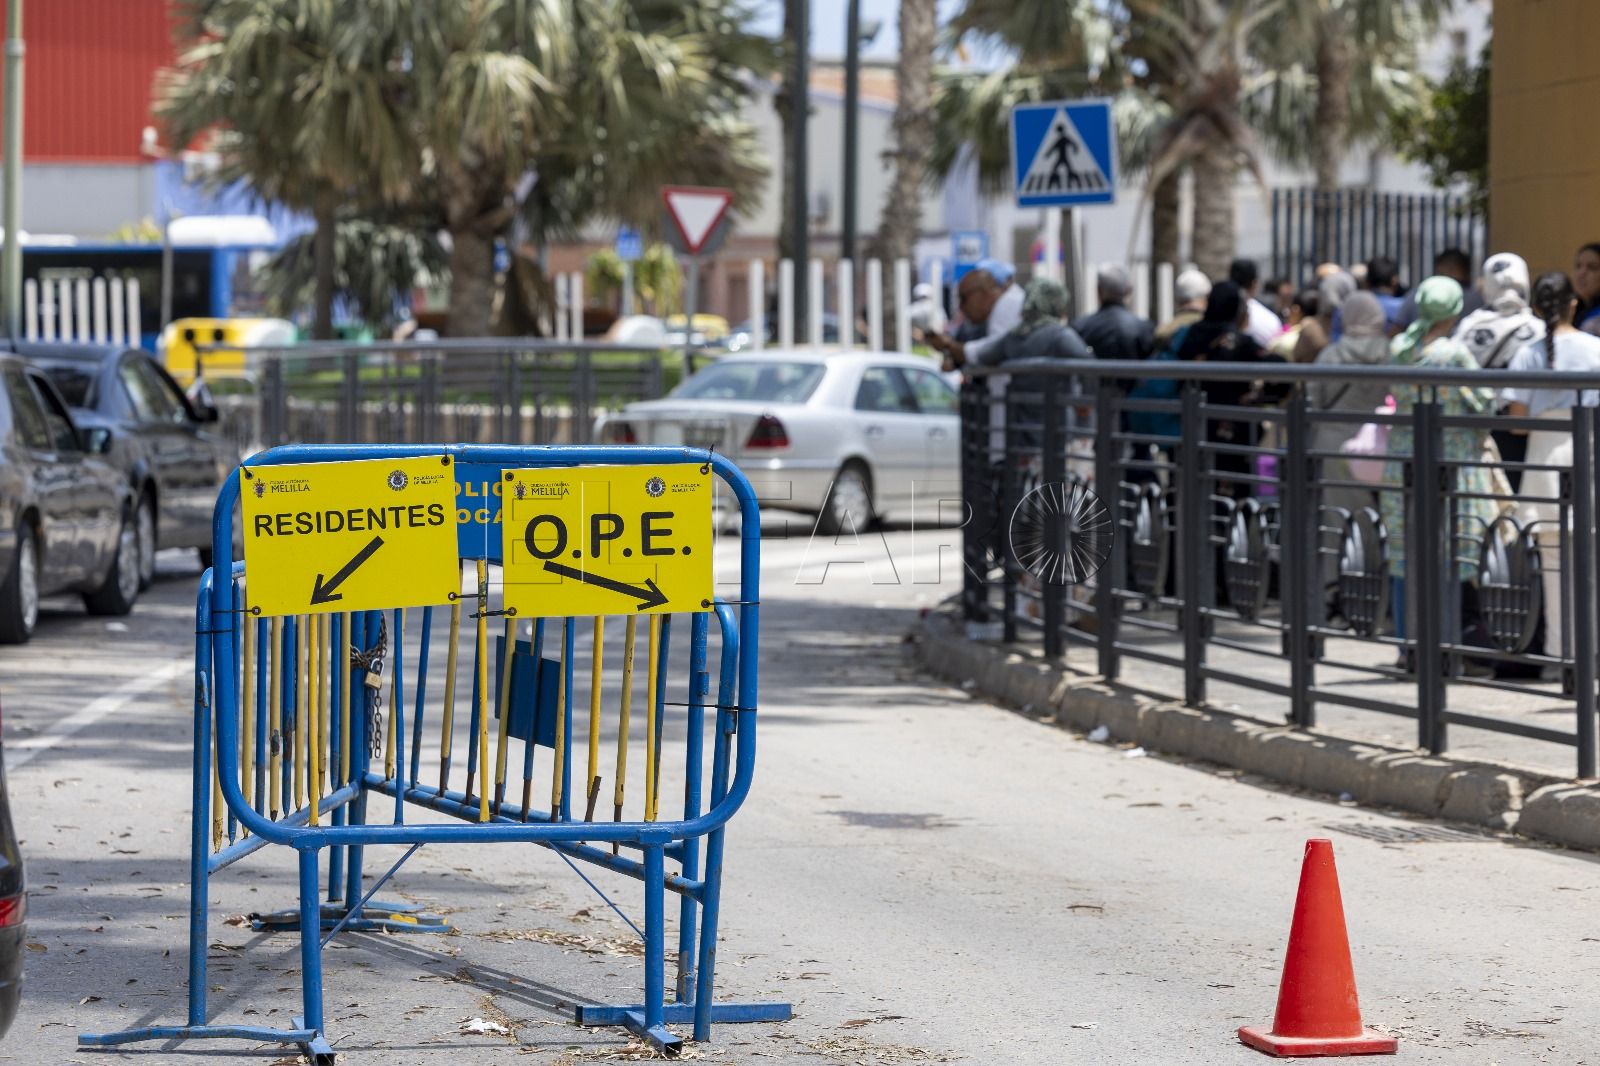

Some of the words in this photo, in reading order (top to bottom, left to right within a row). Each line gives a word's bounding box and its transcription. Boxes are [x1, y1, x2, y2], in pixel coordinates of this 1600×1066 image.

[271, 484, 310, 493] MELILLA
[531, 487, 570, 496] MELILLA
[254, 503, 445, 537] RESIDENTES
[456, 508, 502, 524] OCA
[524, 511, 692, 559] O.P.E.
